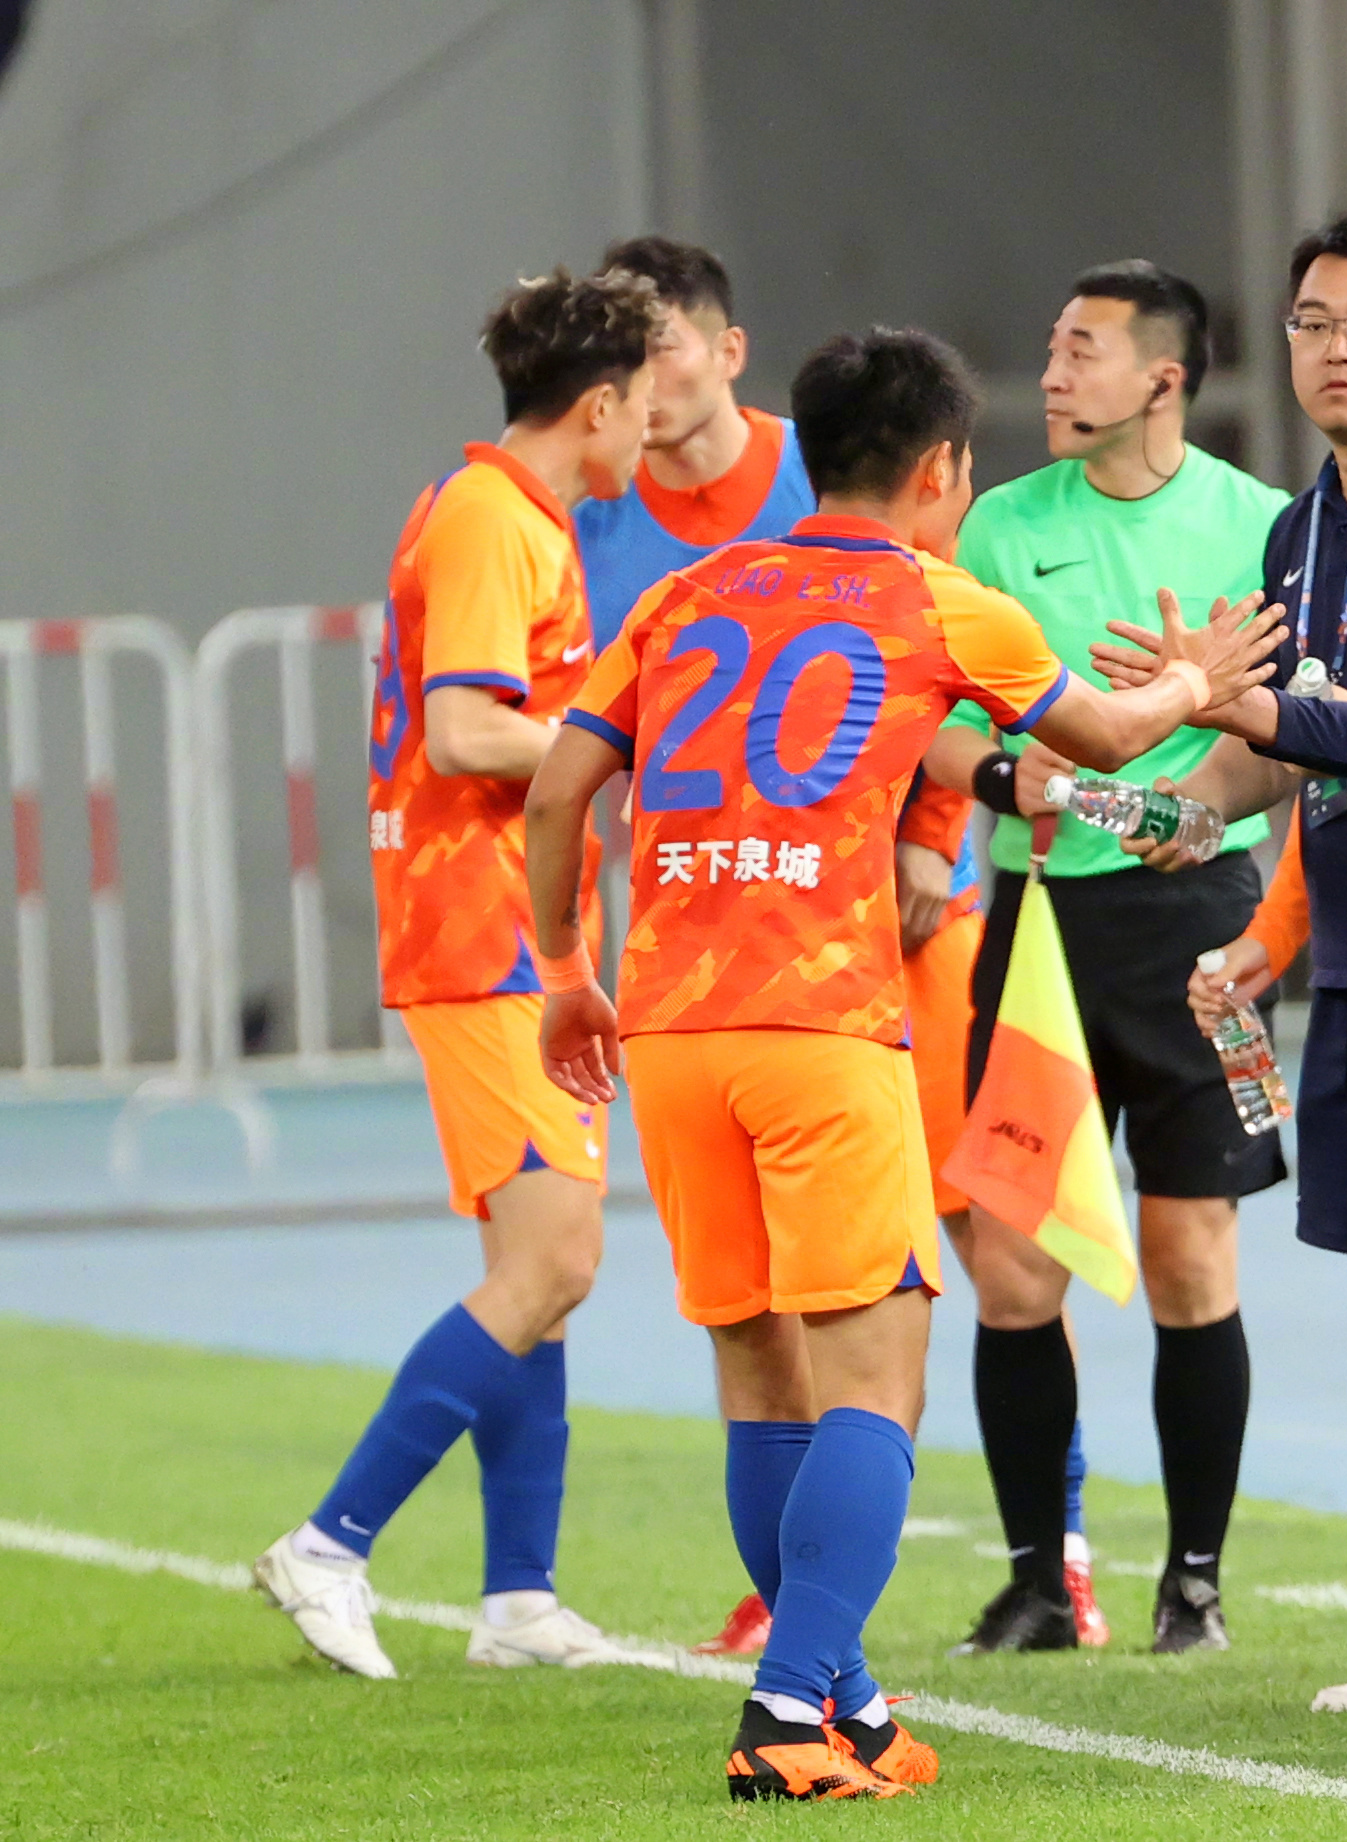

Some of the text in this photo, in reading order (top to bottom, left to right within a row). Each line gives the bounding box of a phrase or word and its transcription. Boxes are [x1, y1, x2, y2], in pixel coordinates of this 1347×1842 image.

[715, 567, 783, 597] LIAO
[641, 614, 887, 812] 20
[656, 836, 822, 889] 天下泉城
